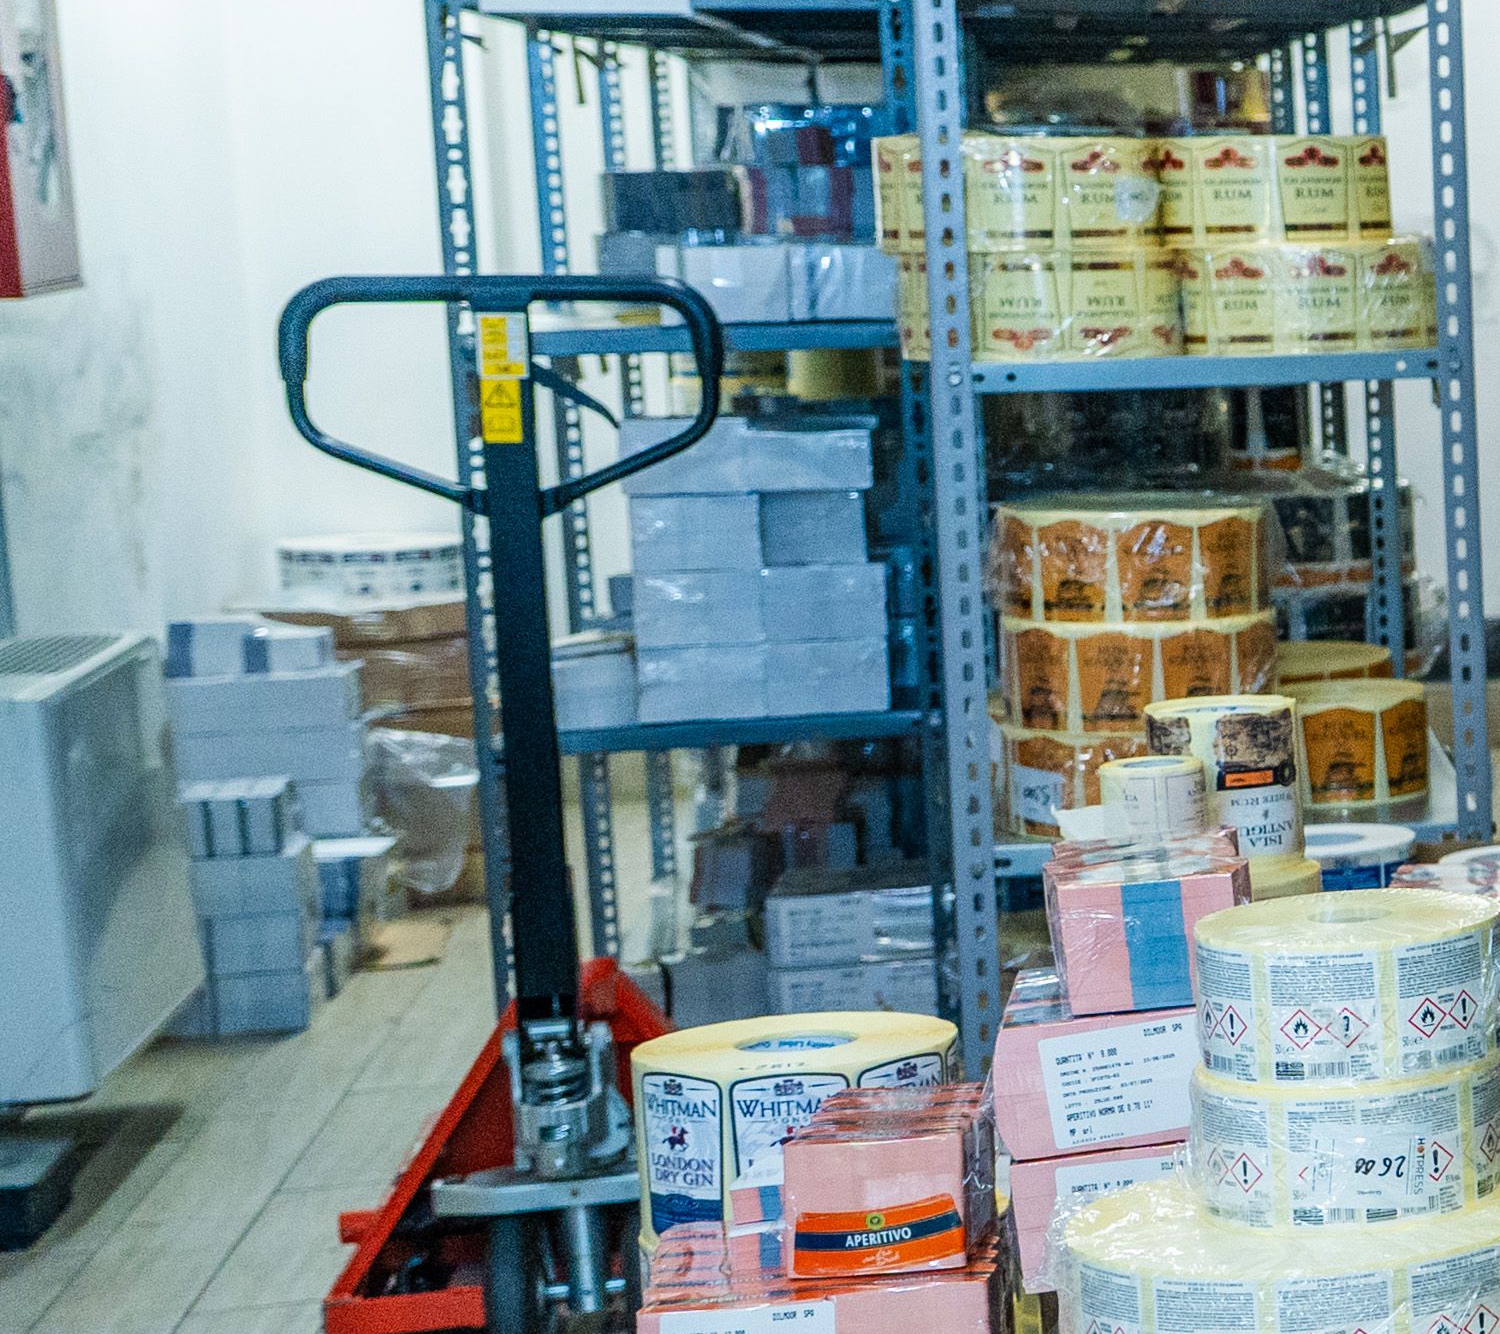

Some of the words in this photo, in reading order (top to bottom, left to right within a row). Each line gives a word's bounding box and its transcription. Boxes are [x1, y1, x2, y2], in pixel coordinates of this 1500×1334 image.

[1249, 836, 1284, 847] ISLA
[647, 1094, 717, 1117] WHITMAN
[736, 1097, 824, 1117] WHITMA
[1066, 1110, 1096, 1122] APERITIVO
[1099, 1105, 1116, 1116] NORMA
[651, 1153, 714, 1172] LONDON
[654, 1168, 678, 1184] DRY
[683, 1171, 713, 1186] GIN
[845, 1227, 912, 1247] APERITIVO
[772, 1311, 797, 1322] DILMOOR
